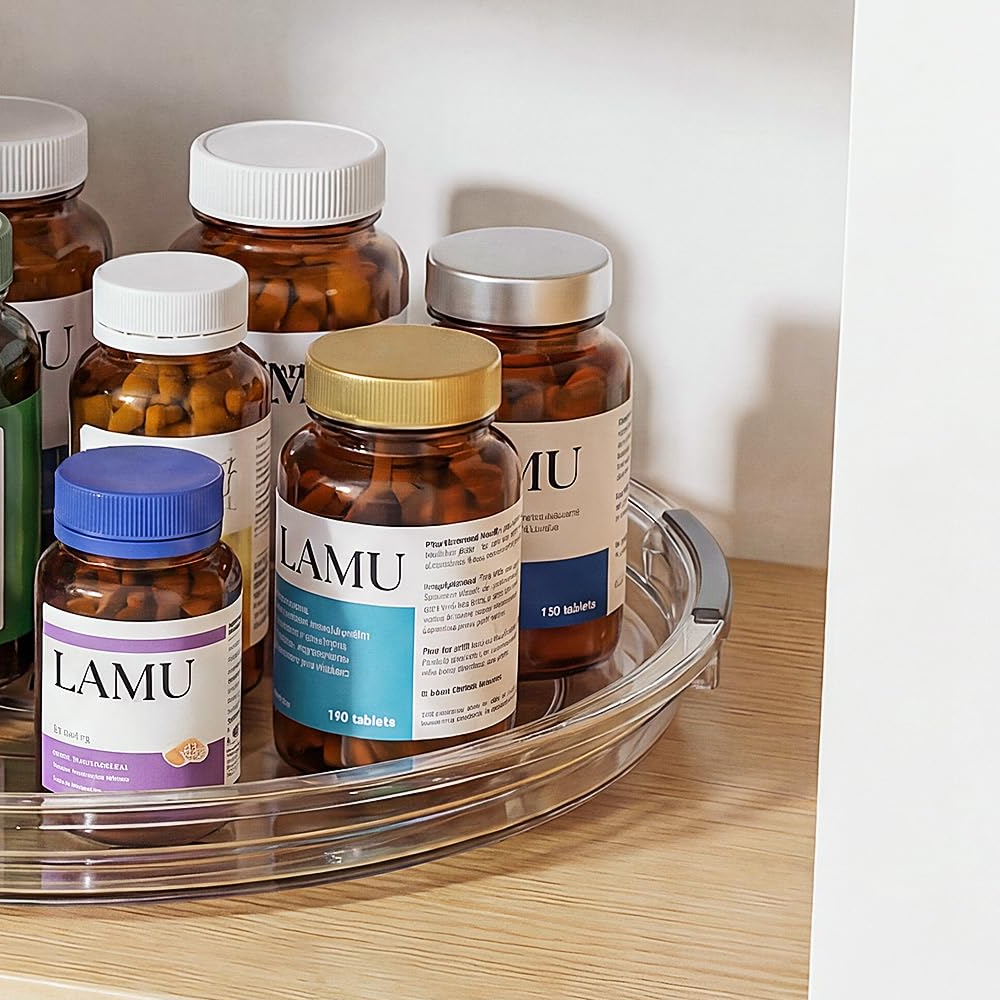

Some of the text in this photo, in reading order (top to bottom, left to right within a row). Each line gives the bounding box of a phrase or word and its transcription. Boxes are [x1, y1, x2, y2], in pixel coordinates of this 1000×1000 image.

[281, 525, 406, 591] LAMU
[541, 600, 596, 617] 150 tablets
[54, 649, 195, 700] LAMU
[328, 709, 396, 728] 190 tablets
